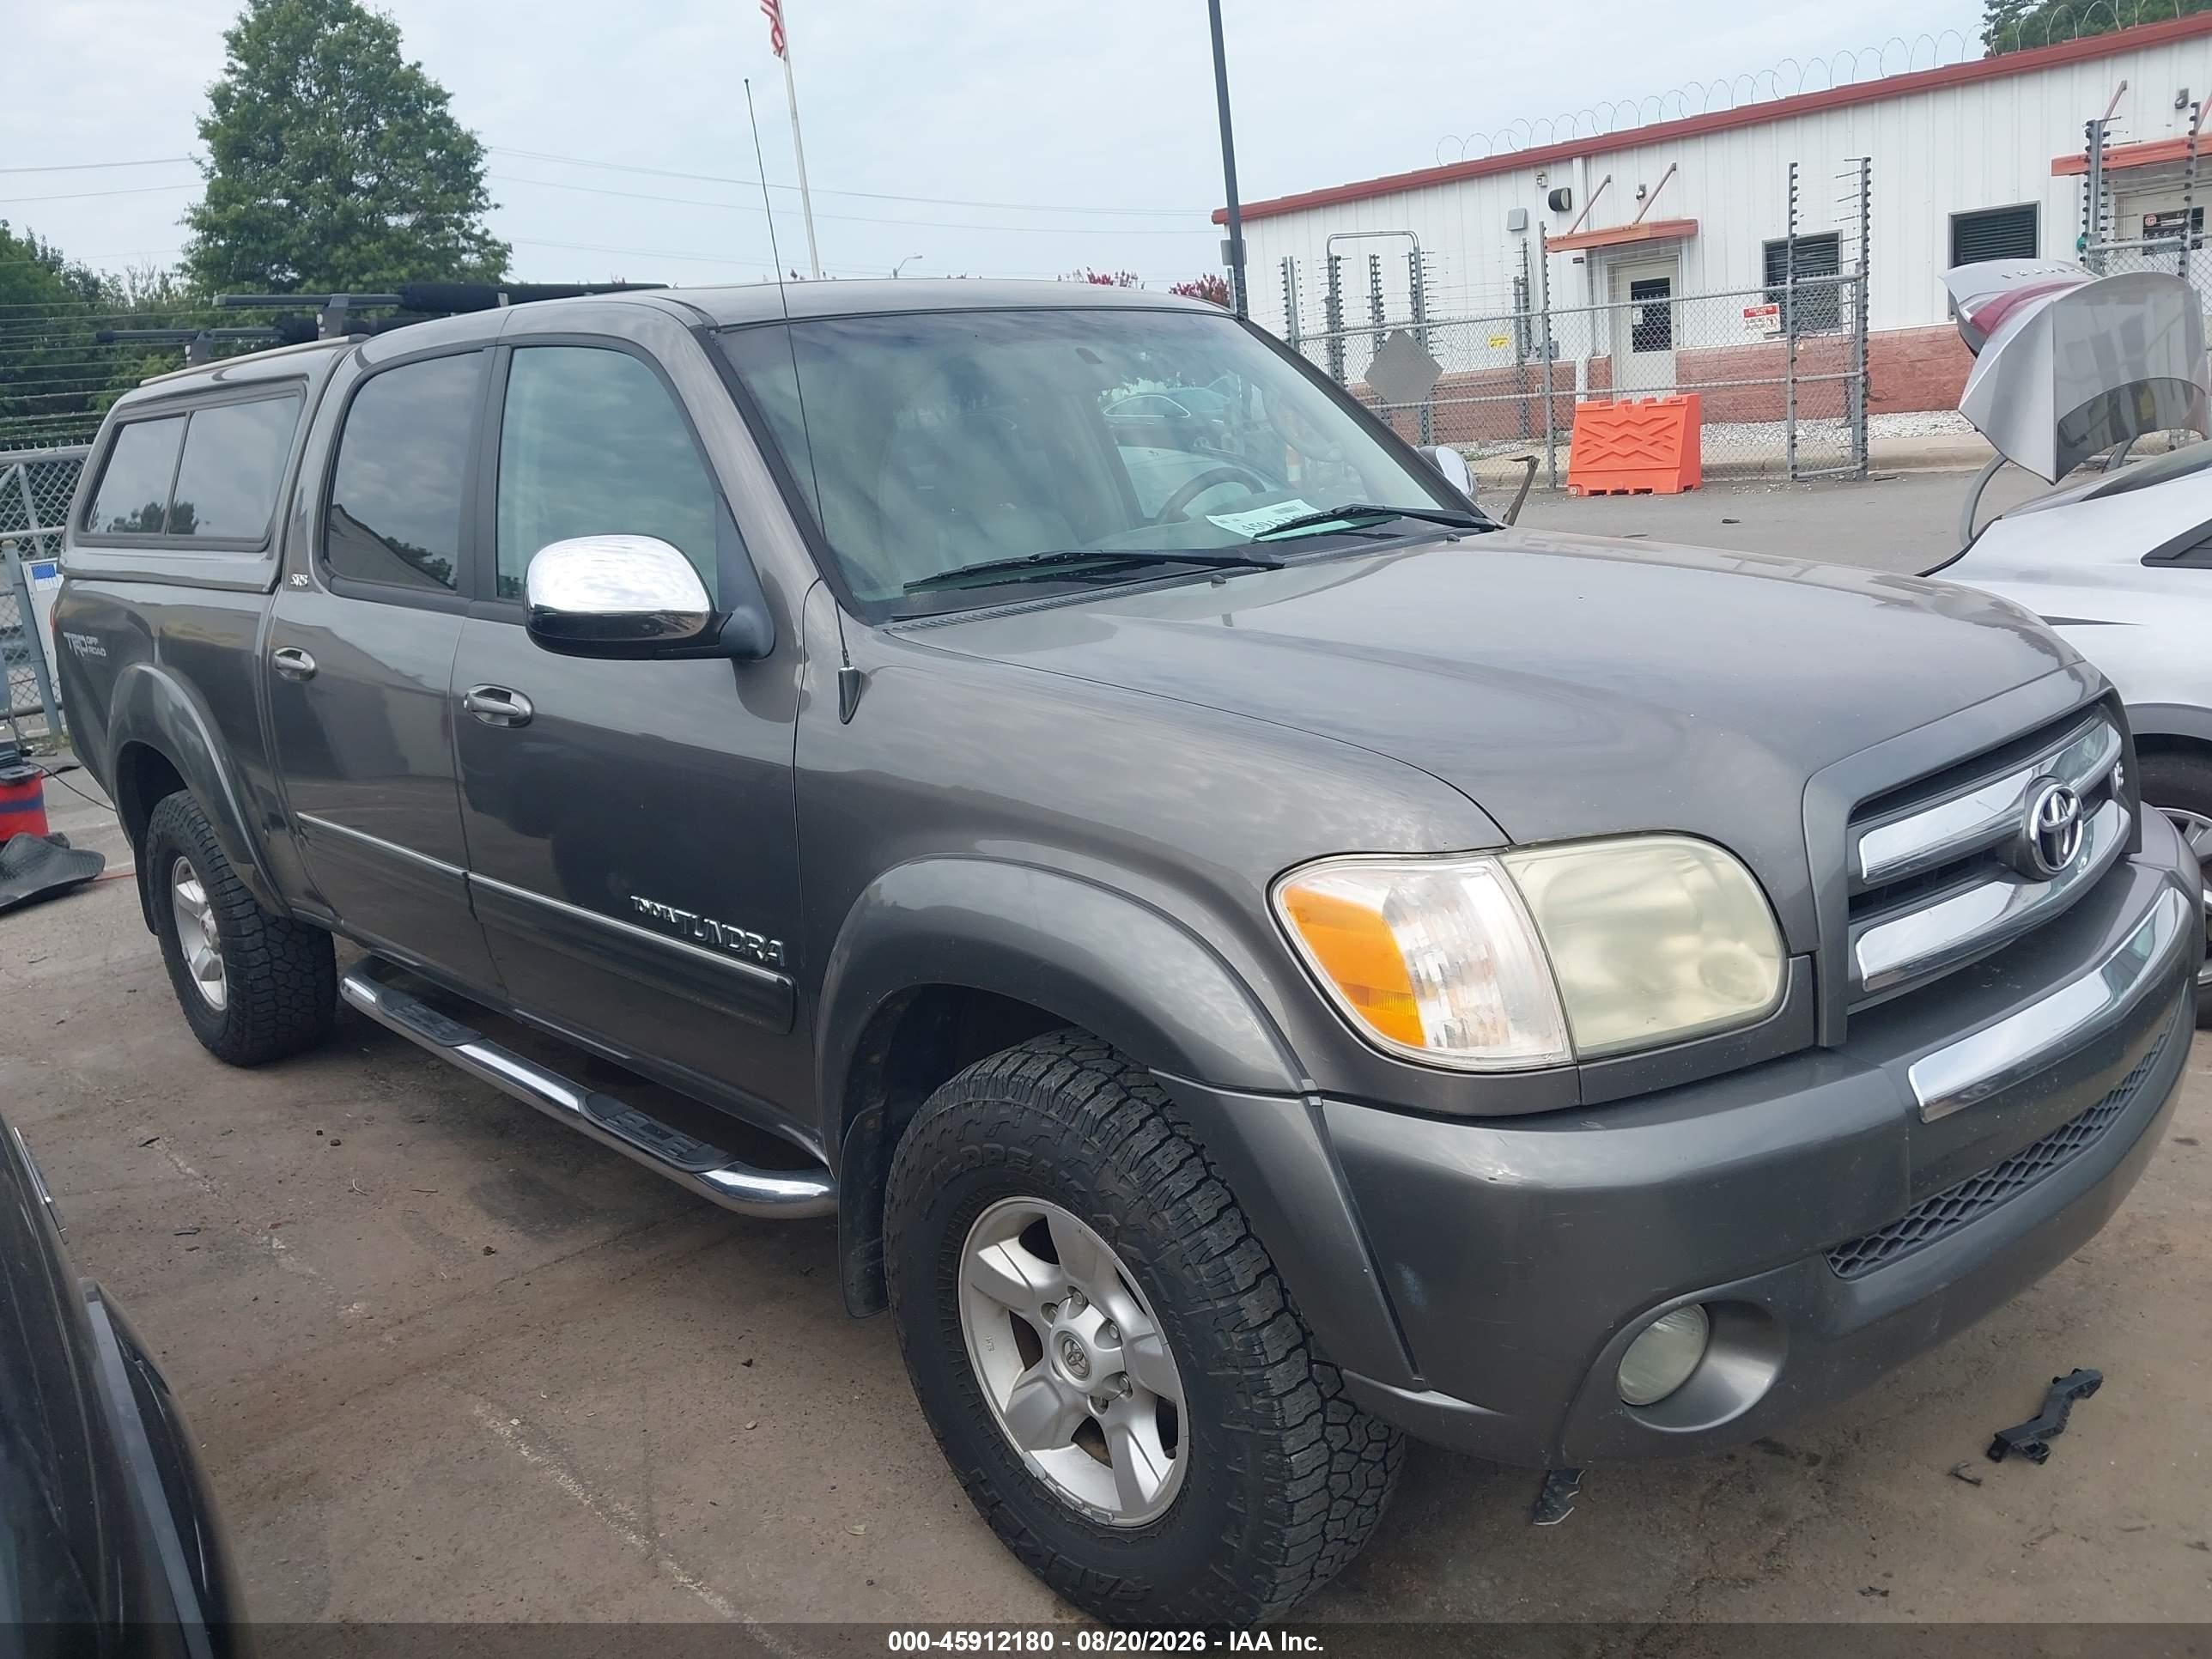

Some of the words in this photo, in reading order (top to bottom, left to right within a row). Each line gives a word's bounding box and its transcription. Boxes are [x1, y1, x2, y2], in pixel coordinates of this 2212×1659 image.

[86, 635, 98, 646] OFF
[88, 645, 106, 657] ROAD
[630, 896, 677, 922] TOYOTA
[674, 908, 785, 967] TUNDRA
